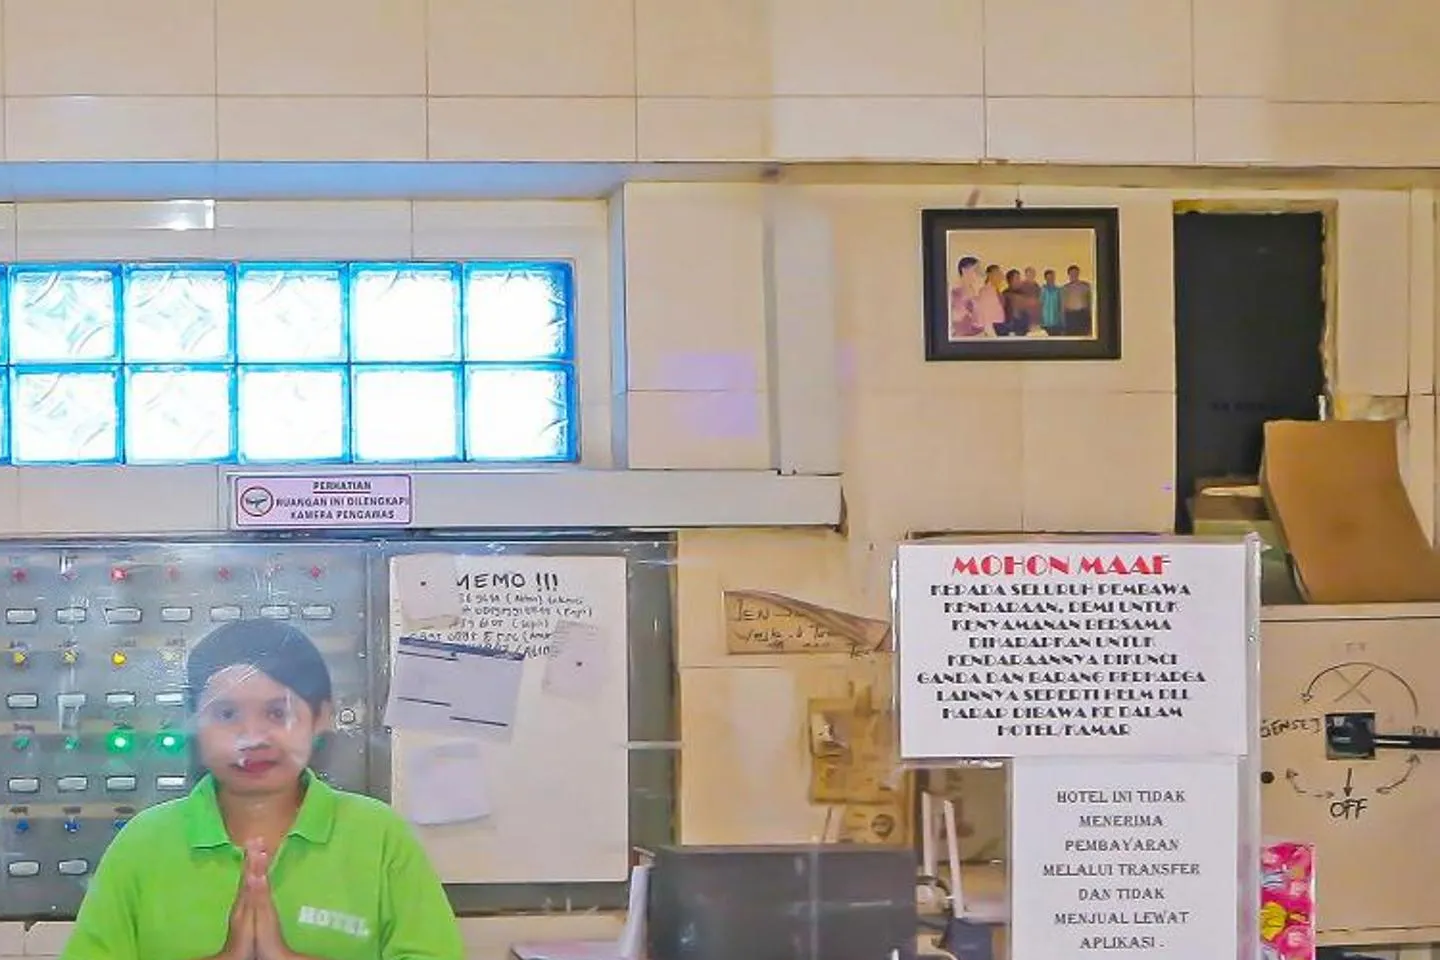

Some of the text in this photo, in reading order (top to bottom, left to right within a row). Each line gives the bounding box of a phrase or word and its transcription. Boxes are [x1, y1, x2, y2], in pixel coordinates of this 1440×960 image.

[313, 482, 372, 490] PERHATIAN
[276, 496, 327, 507] RUANGAN
[330, 496, 345, 506] INI
[336, 510, 396, 520] PENGAWAS
[952, 554, 1172, 577] MOHON MAAF
[930, 583, 1192, 597] KEPADA SELURUH PEMBAWA
[1068, 601, 1114, 614] DEMI
[1117, 601, 1181, 614] UNTUK
[951, 618, 1173, 631] KENYAMANAN BERSAMA
[968, 636, 1157, 649] DIHARAPKAN UNTUK
[947, 653, 1179, 667] KENDARAANNYA DIKUNCI
[916, 671, 1207, 685] GANDA DAN BARANG BERHARGA
[936, 689, 1019, 702] LAINNYA
[1023, 689, 1100, 701] SEPERTI
[1104, 689, 1155, 701] HELM
[941, 706, 1009, 719] HARAP
[1012, 706, 1087, 719] DIBAWA
[1118, 706, 1184, 718] DALAM
[996, 724, 1132, 737] HOTEL/KAMAR
[1056, 790, 1186, 804] HOTEL INI TIDAK
[1329, 797, 1368, 820] OFF
[1078, 814, 1164, 828] MENERIMA
[1064, 838, 1180, 852] PEMBAYARAN
[1042, 863, 1201, 876] MELALUI TRANSFER
[1078, 887, 1166, 901] DAN TIDAK
[1054, 911, 1191, 925] MENJUAL LEWAT
